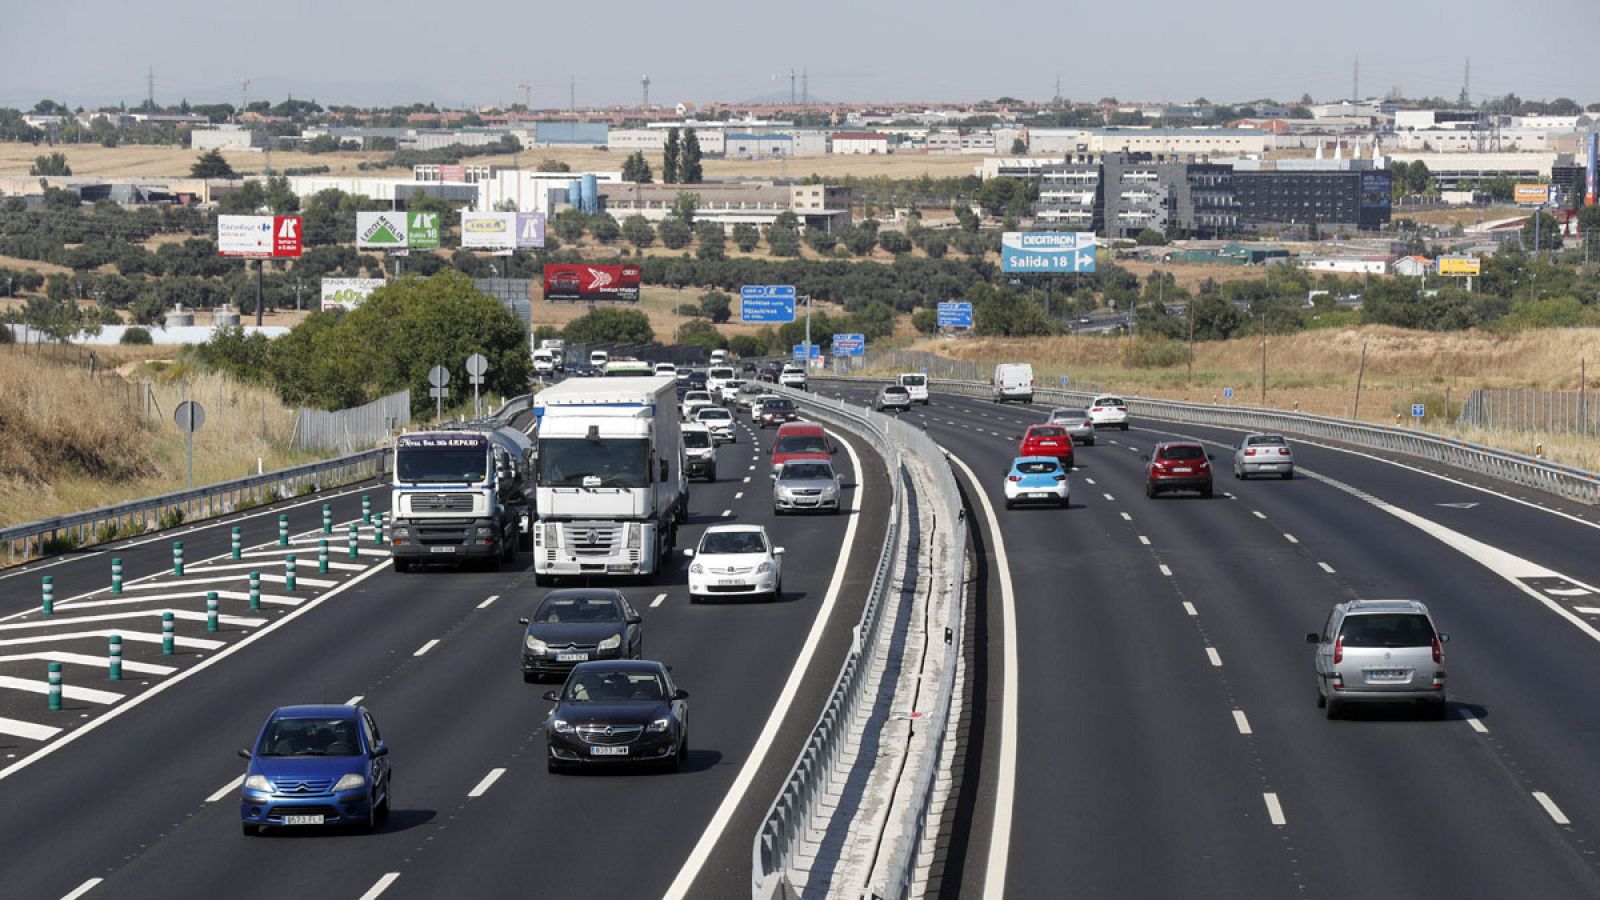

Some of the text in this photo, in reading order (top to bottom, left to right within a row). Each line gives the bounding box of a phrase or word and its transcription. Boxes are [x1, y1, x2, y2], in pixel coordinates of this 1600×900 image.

[360, 215, 406, 241] LEROY MERLIN
[1023, 235, 1074, 245] DECATHLON
[1010, 255, 1067, 268] Salida 18
